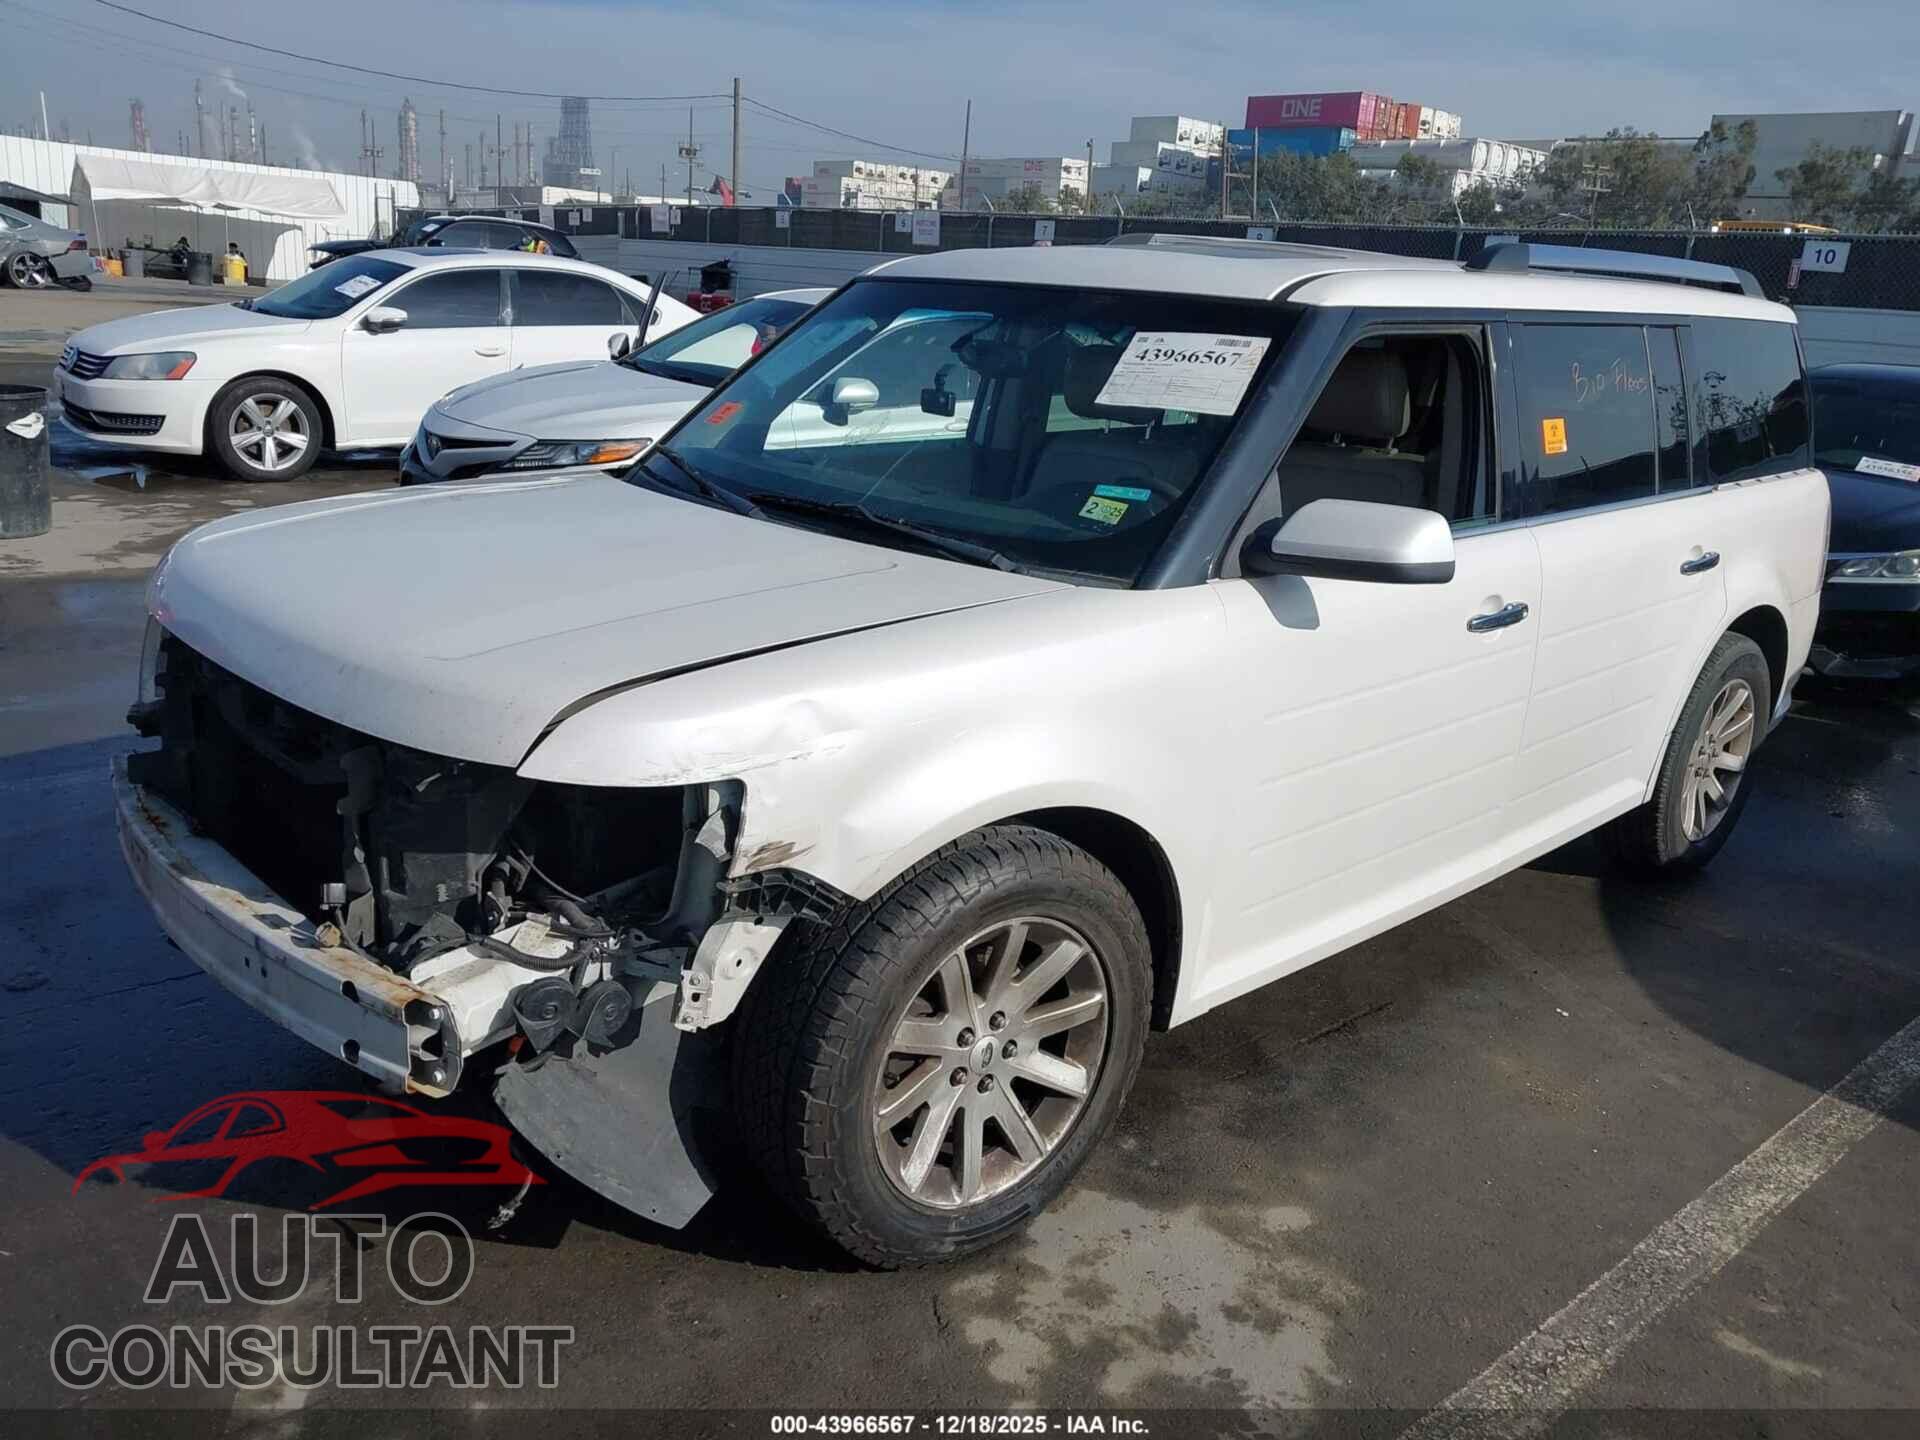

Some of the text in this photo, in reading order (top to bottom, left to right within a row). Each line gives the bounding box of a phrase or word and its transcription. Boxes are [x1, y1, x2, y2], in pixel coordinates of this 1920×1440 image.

[1281, 98, 1322, 118] ONE
[1815, 248, 1837, 265] 10
[1135, 347, 1243, 369] 43966567
[1086, 501, 1099, 514] 2
